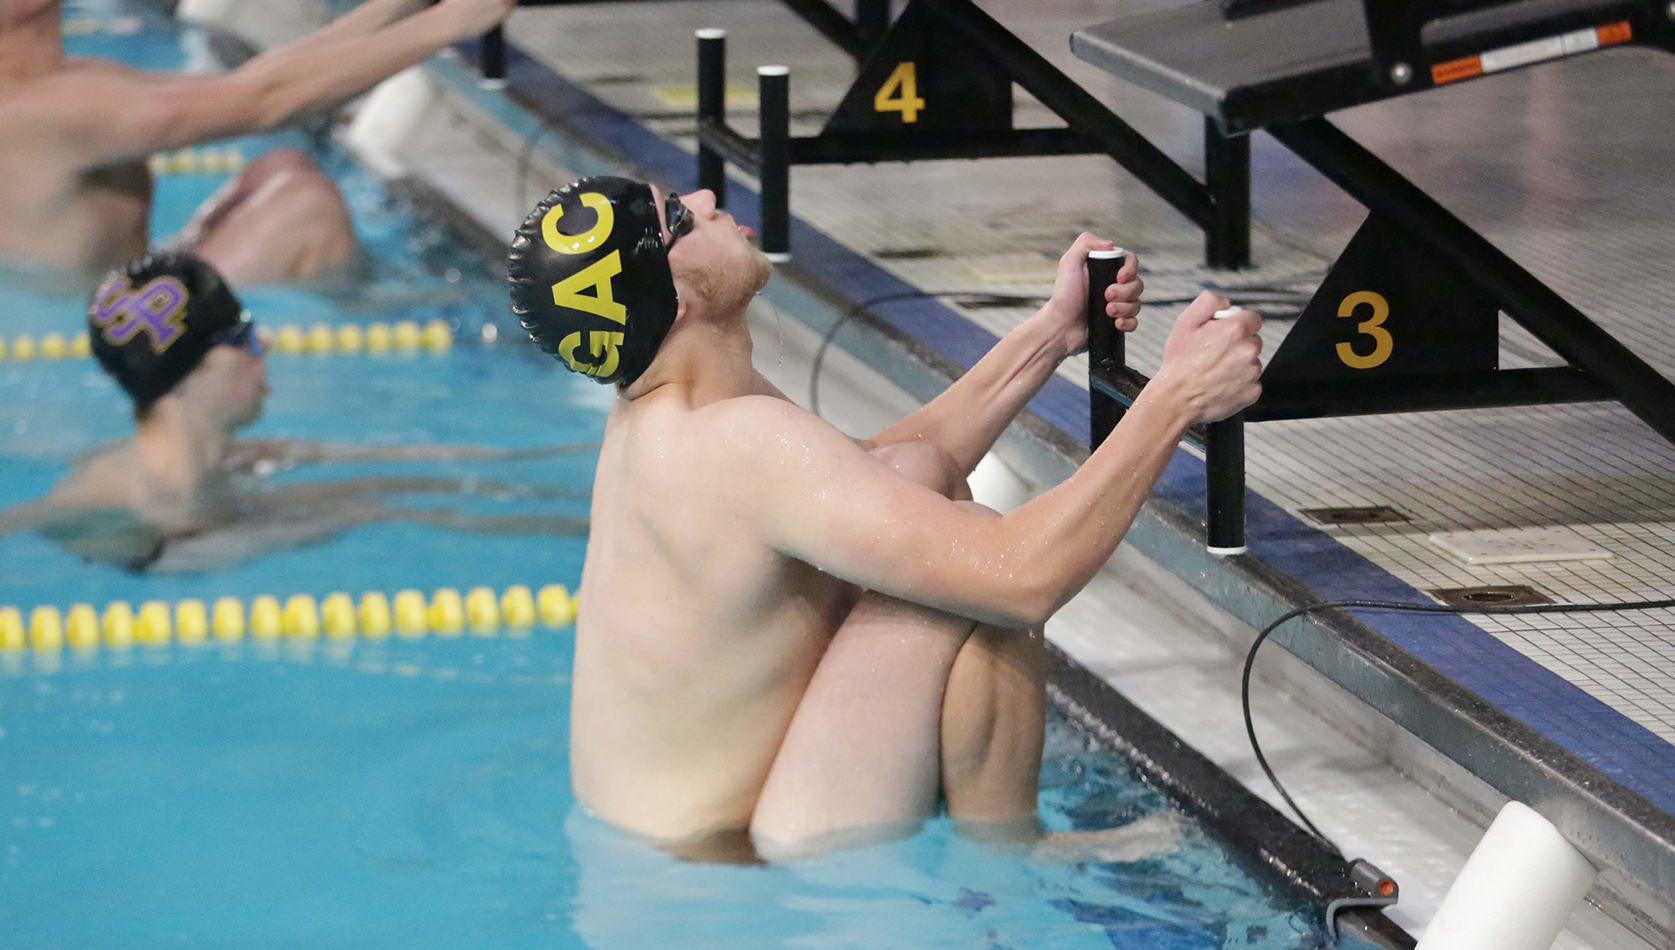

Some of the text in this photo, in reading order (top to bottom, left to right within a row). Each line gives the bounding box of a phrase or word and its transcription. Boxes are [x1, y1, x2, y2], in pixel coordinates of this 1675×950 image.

[875, 62, 925, 123] 4
[541, 191, 627, 378] GAC
[1336, 291, 1393, 369] 3
